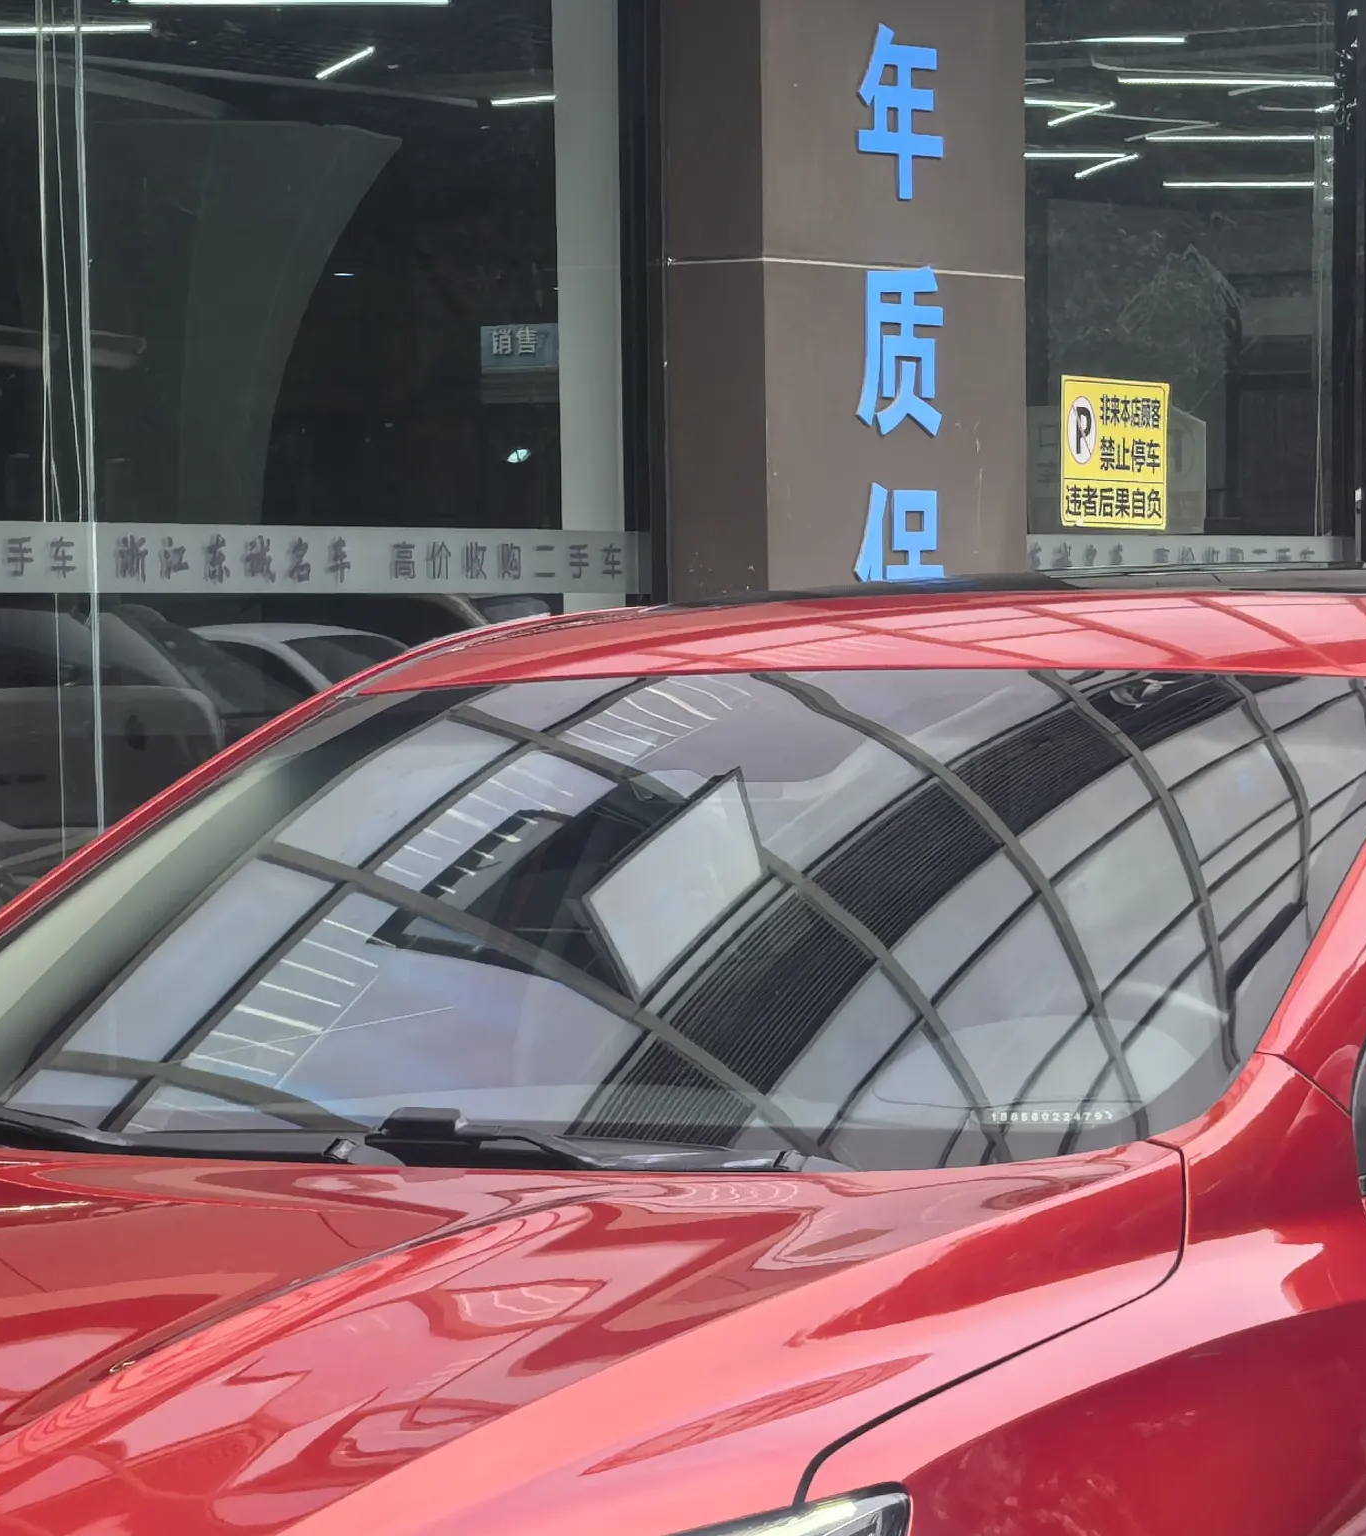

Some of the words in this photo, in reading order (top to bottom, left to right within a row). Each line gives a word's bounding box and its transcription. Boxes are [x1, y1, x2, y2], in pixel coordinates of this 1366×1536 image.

[1099, 394, 1162, 429] 非来本店顾客
[1100, 436, 1161, 474] 禁止停车
[1065, 484, 1163, 519] 违者后果自负
[116, 534, 351, 583] 浙江东诚名车
[392, 541, 624, 581] 高价收购二手车
